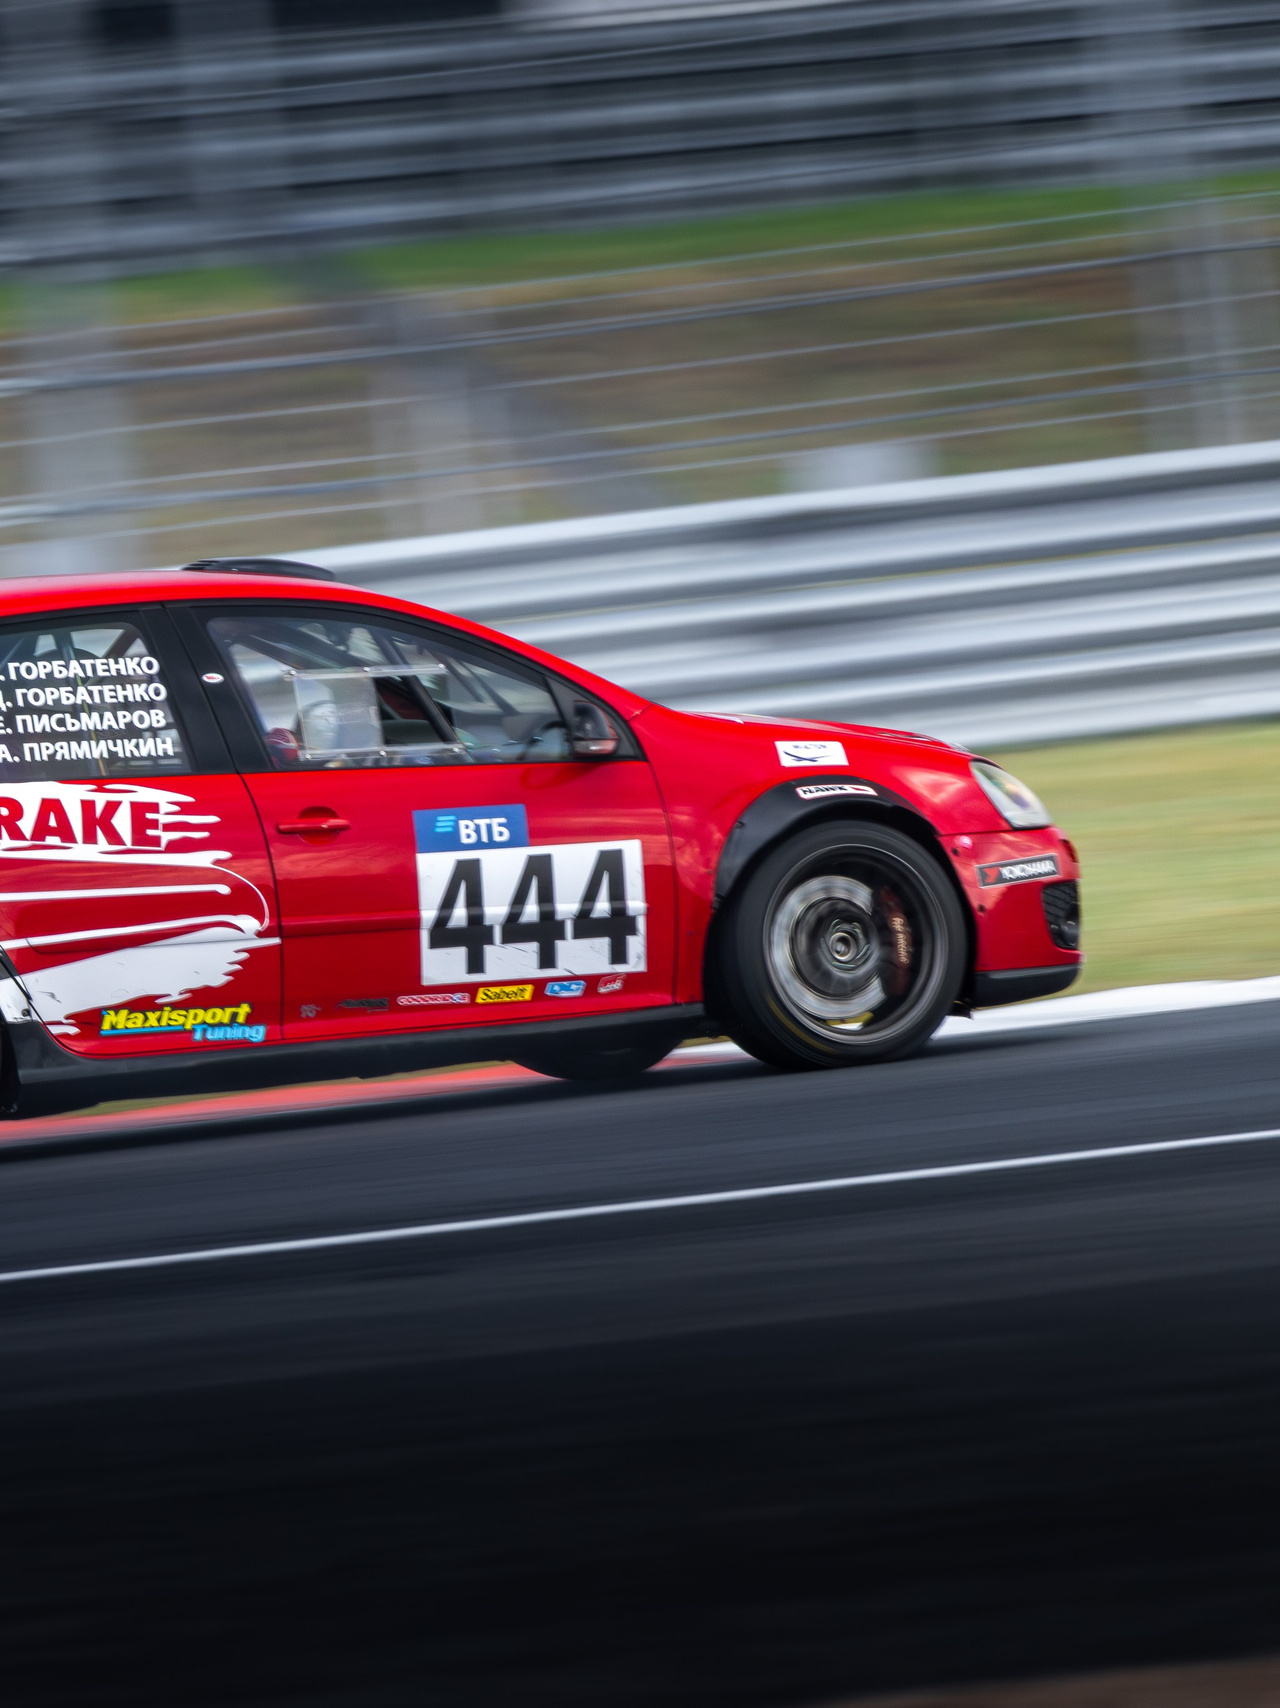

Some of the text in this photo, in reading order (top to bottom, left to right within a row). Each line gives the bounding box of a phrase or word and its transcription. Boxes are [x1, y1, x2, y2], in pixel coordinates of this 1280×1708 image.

[8, 656, 161, 682] ГОРБАТЕНКО
[15, 683, 168, 707] ГОРБАТЕНКО
[15, 709, 167, 734] ПИСЬМАРОВ
[23, 737, 175, 762] ПРЯМИЧКИН
[458, 817, 511, 844] ВТБ
[429, 848, 638, 975] 444
[101, 1003, 252, 1031] Maxisport
[191, 1023, 267, 1043] Tuning
